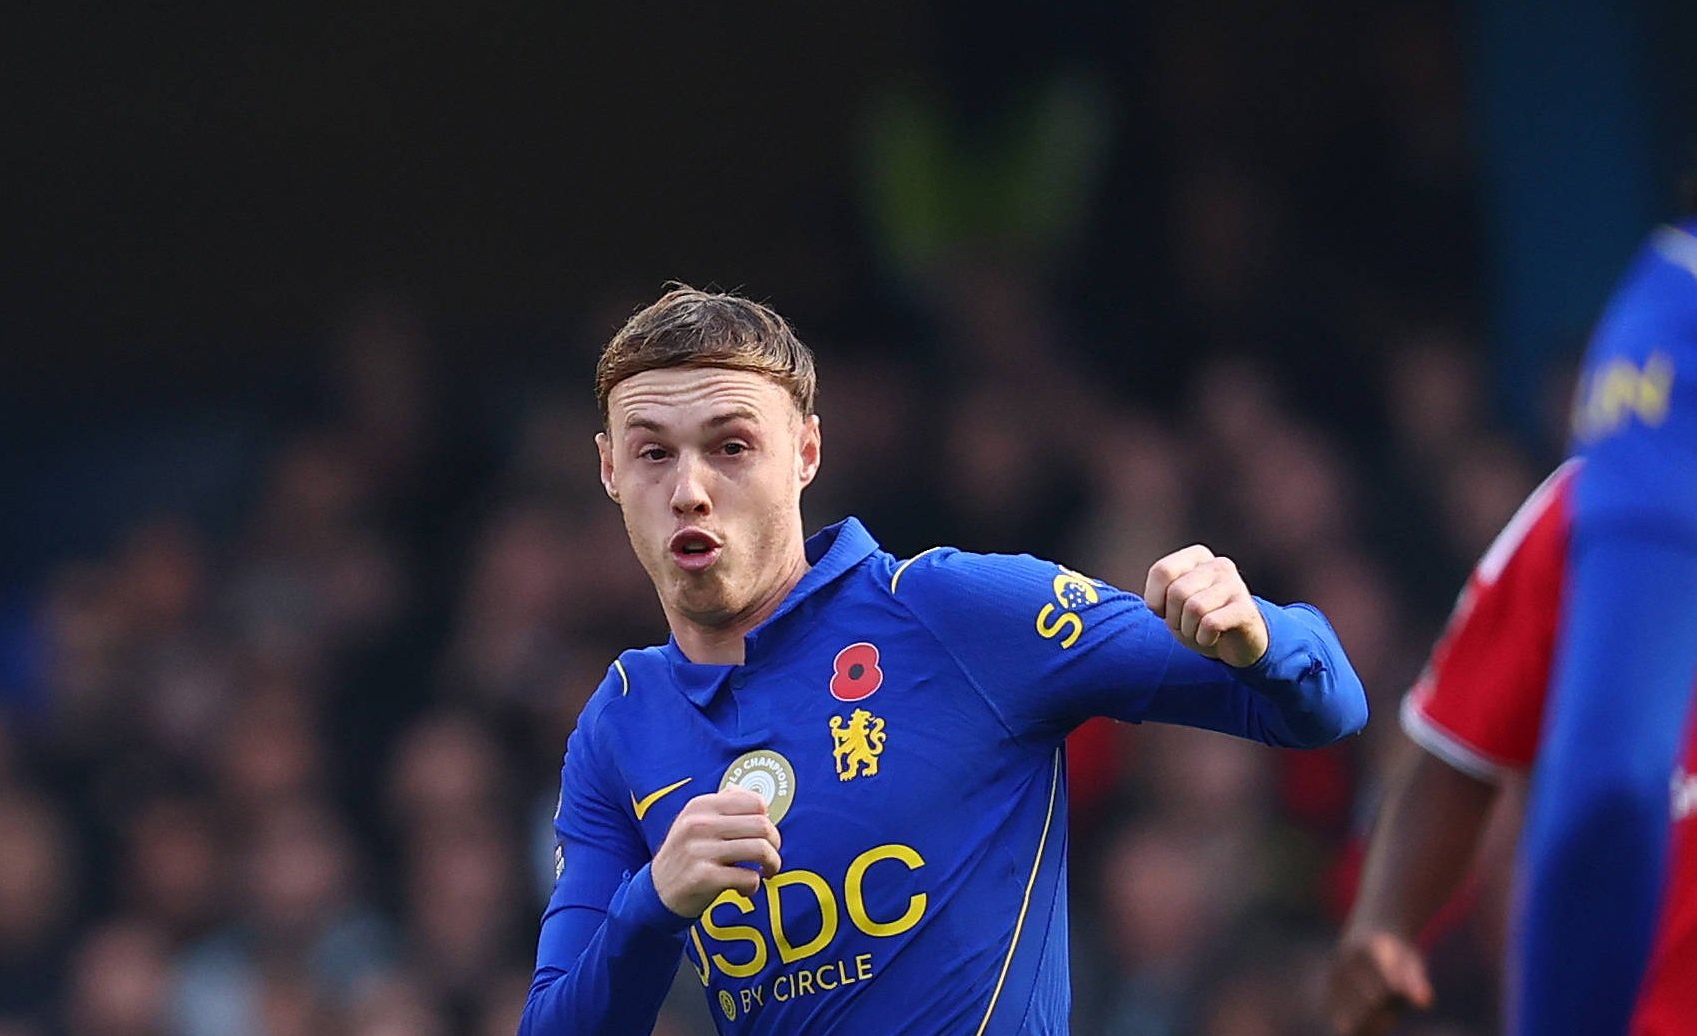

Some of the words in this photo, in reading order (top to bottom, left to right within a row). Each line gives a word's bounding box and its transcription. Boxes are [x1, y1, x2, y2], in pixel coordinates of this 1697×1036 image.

[743, 757, 789, 797] CHAMPIONS
[740, 985, 764, 1013] BY
[773, 953, 874, 1002] CIRCLE
